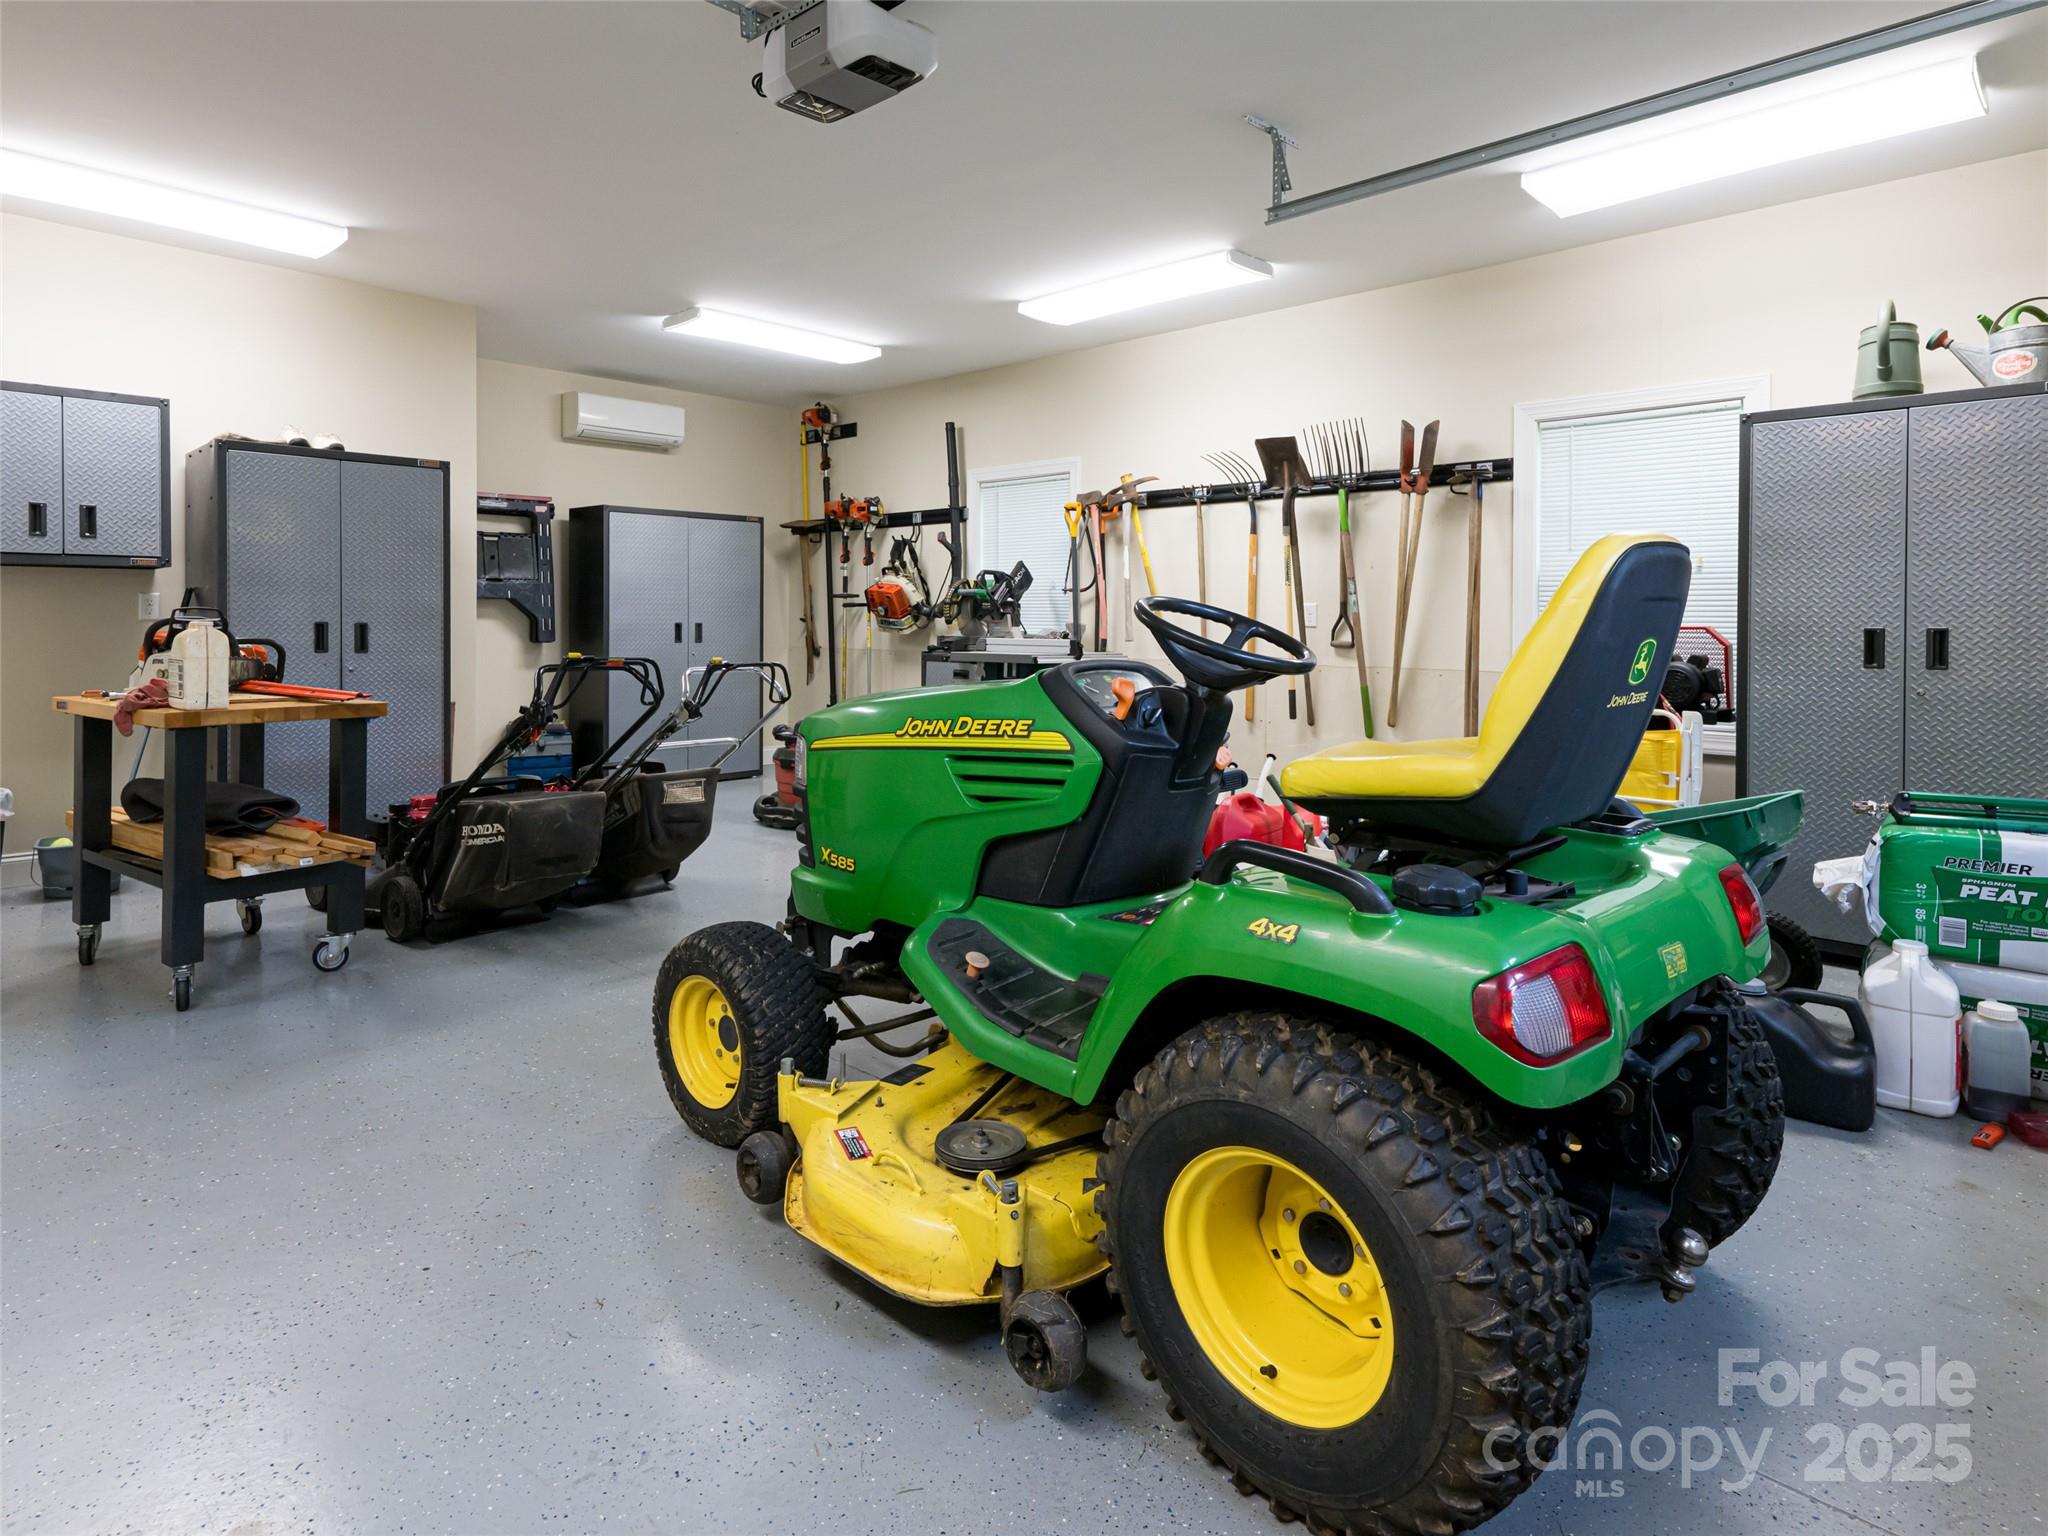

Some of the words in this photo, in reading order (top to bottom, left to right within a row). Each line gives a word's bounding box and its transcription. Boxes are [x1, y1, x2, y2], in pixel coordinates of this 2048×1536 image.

[1606, 694, 1629, 708] JOHN
[1627, 691, 1649, 704] DEERE
[895, 717, 952, 736] JOHN
[952, 716, 1034, 737] DEERE
[462, 823, 505, 836] HONDA
[820, 846, 856, 872] X585
[1944, 856, 2033, 876] PREMIER
[1961, 878, 2017, 888] SPHAGNUM
[1959, 884, 2038, 906] PEAT
